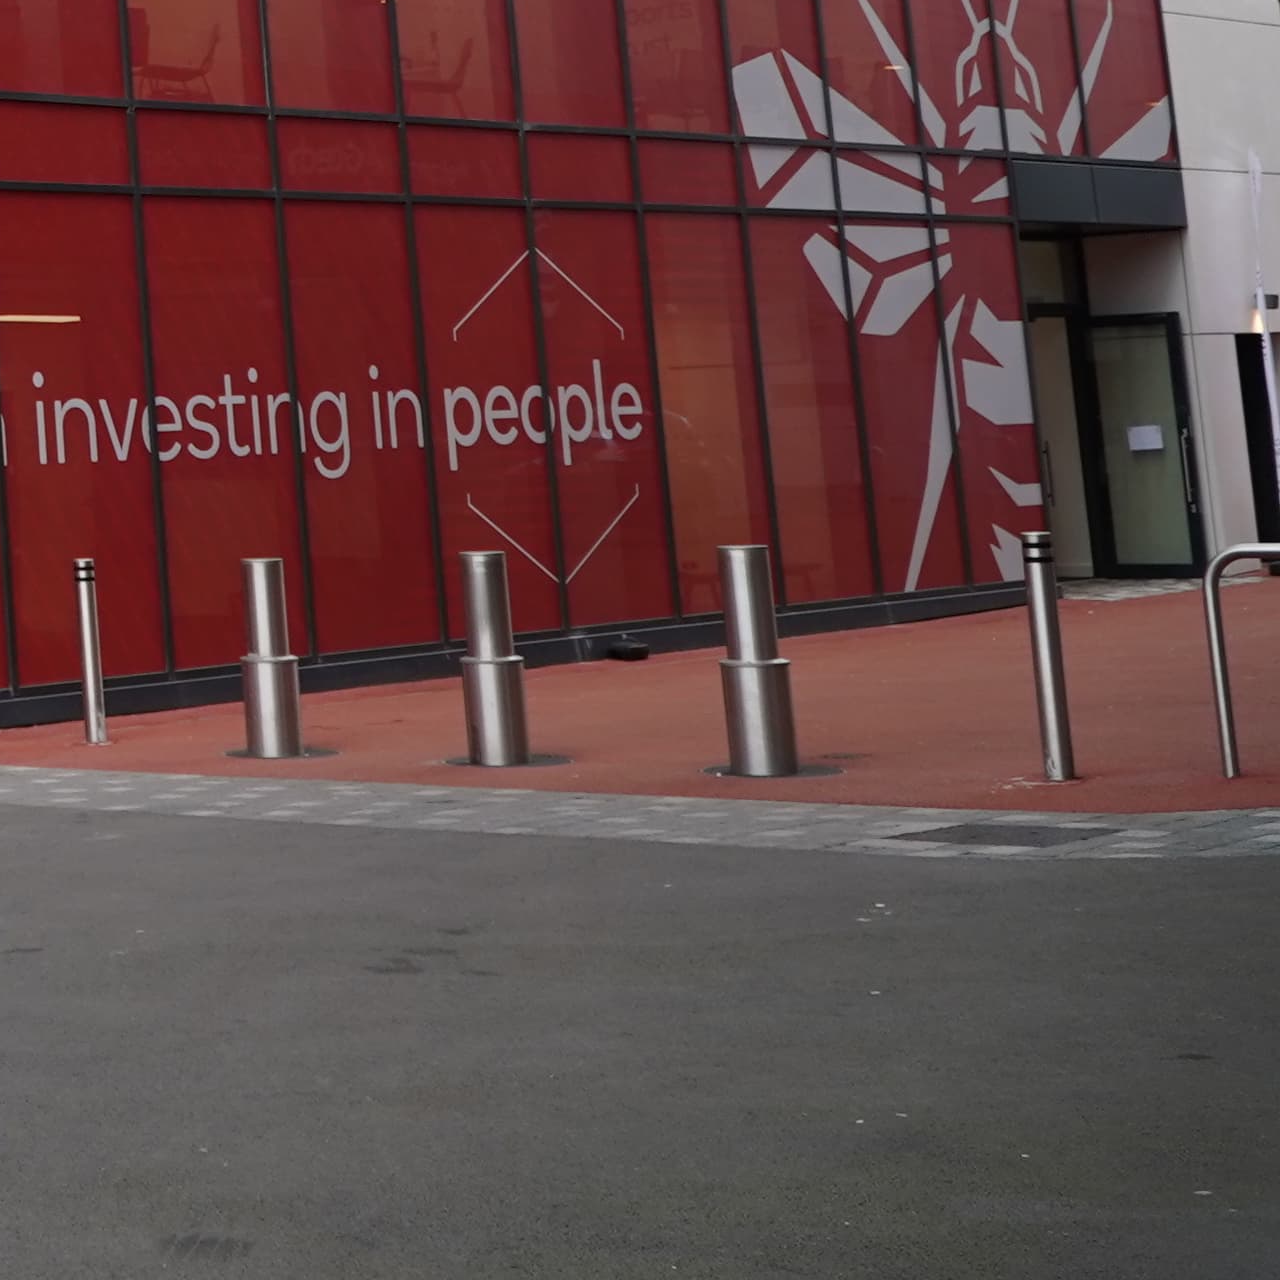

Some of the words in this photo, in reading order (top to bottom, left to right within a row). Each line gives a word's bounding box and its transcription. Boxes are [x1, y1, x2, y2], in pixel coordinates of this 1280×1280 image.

[31, 367, 351, 480] investing
[368, 364, 426, 450] in
[443, 358, 643, 473] people
